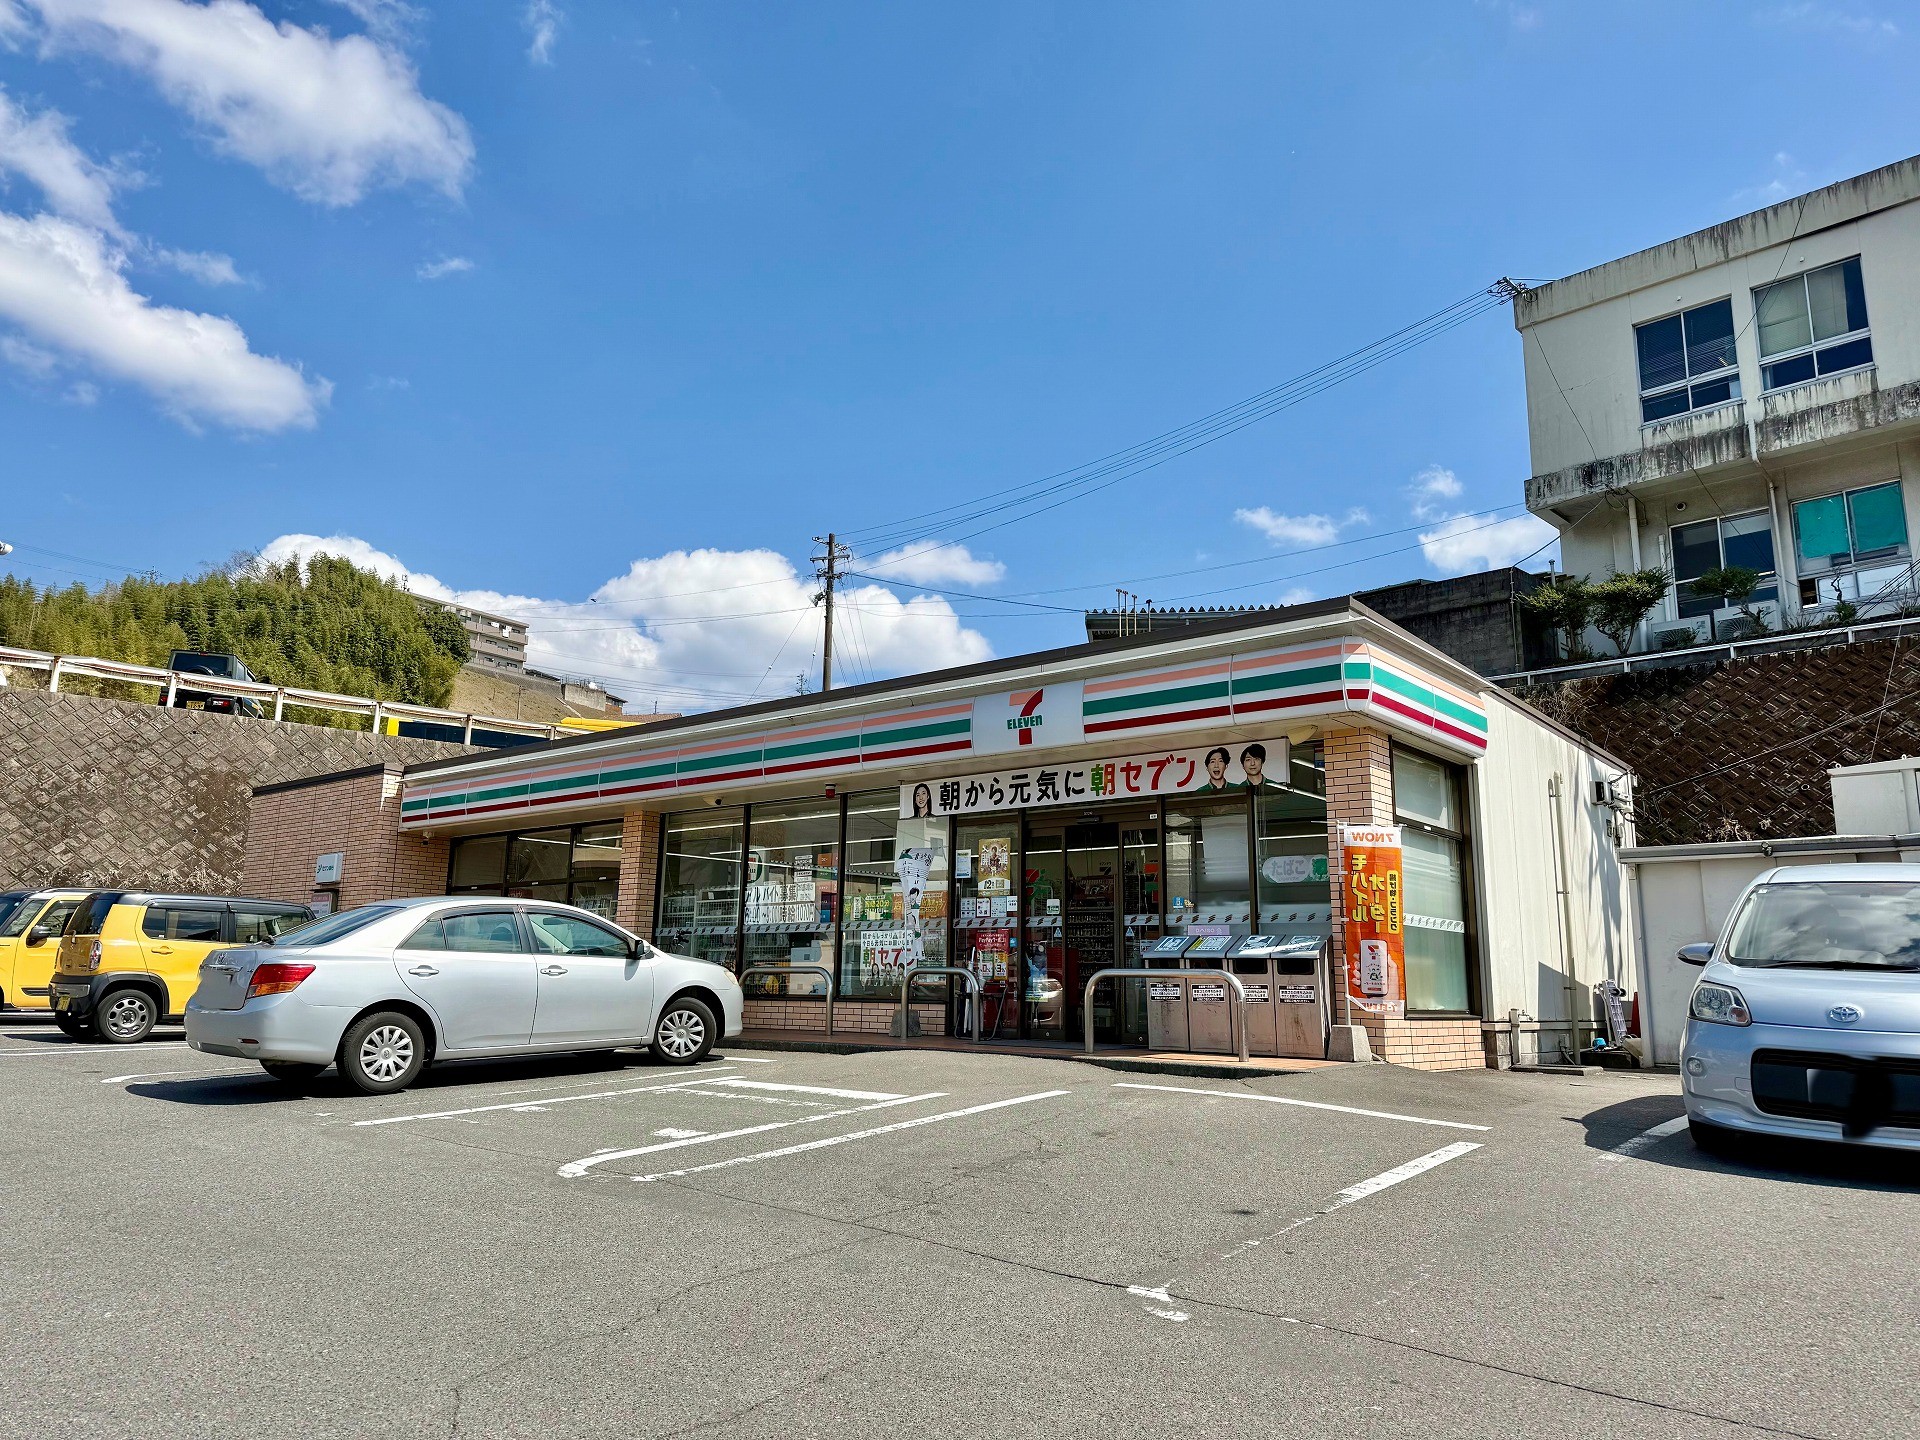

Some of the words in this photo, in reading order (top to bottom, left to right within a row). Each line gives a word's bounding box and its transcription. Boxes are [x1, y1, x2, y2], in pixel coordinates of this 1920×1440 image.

[939, 754, 1196, 811] 朝から元気に朝セブン
[1271, 859, 1305, 877] たばこ
